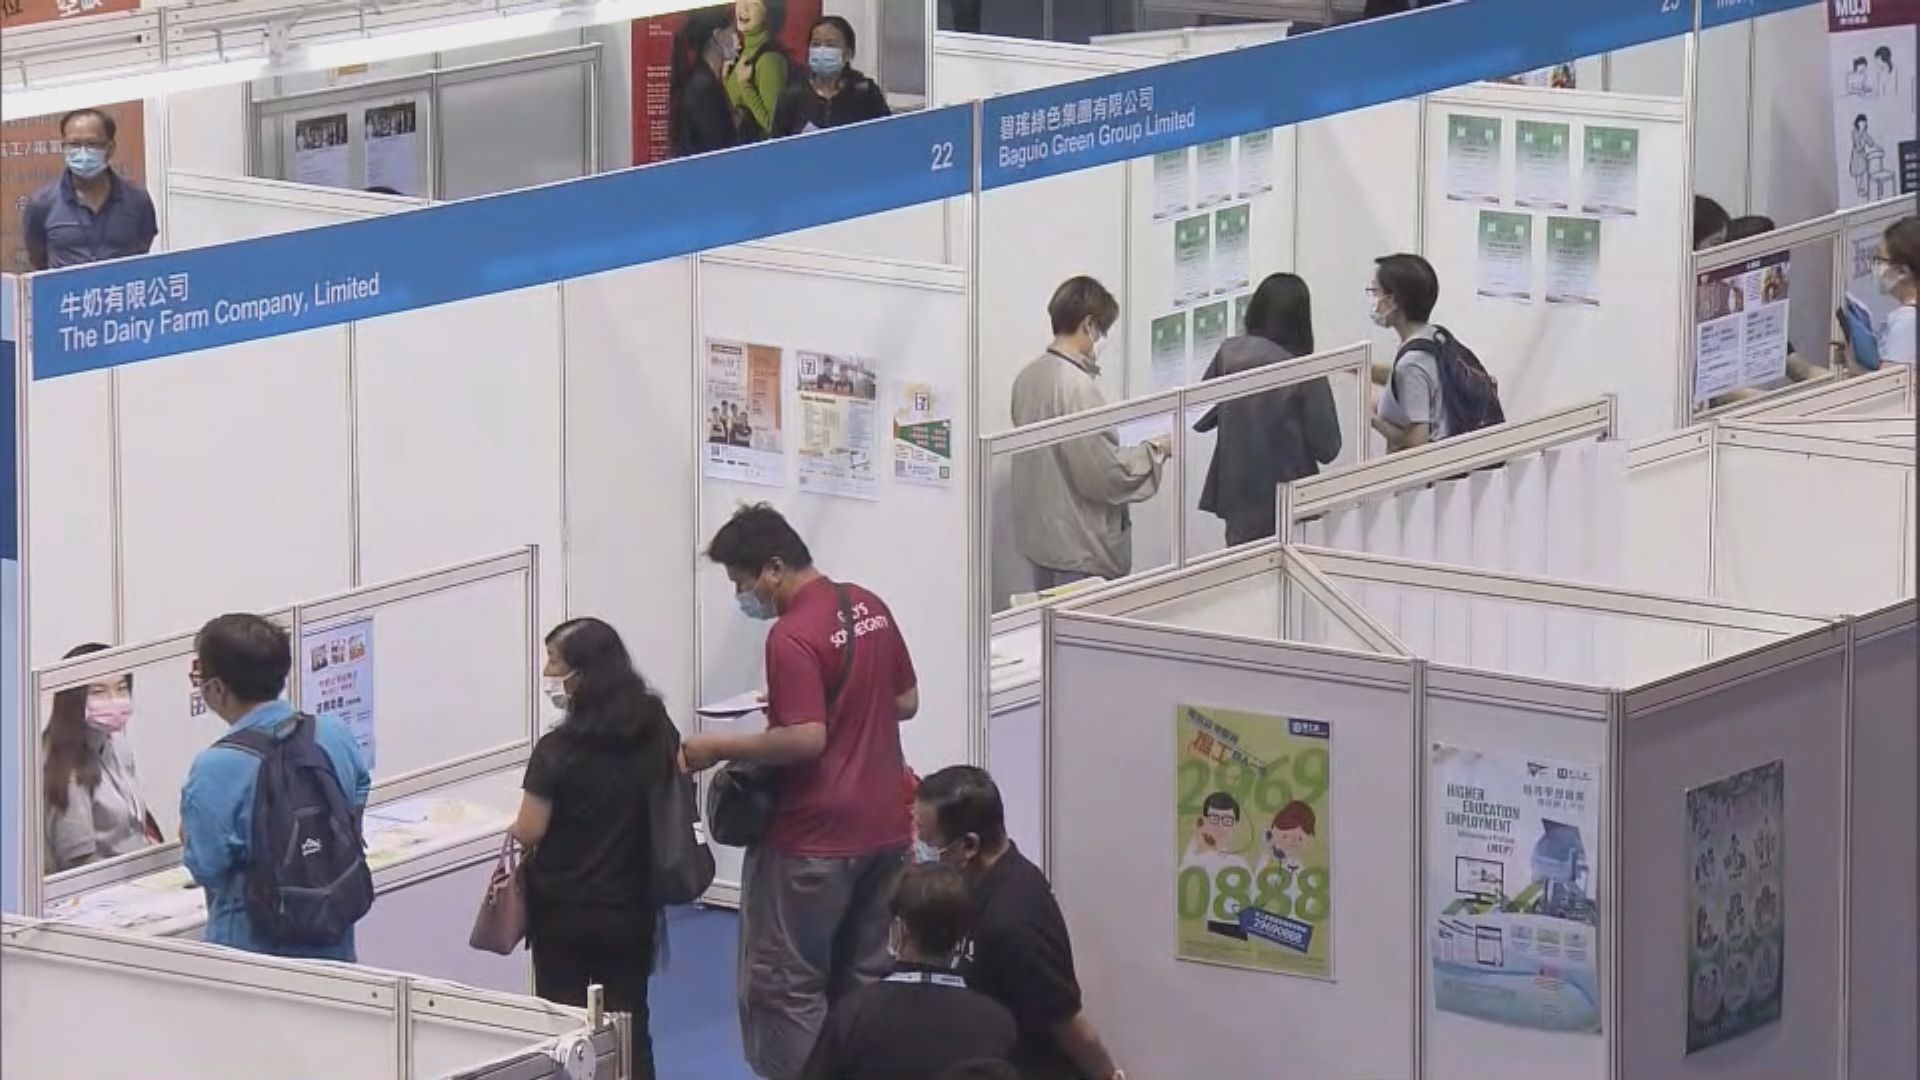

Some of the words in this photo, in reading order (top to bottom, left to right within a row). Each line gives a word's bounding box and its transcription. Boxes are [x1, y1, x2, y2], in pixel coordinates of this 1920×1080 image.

[999, 141, 1049, 169] Baguio
[1052, 131, 1094, 156] Green
[1100, 119, 1142, 146] Group
[1146, 105, 1197, 136] Limited
[930, 142, 953, 171] 22
[60, 272, 188, 320] 牛奶有限公司
[60, 325, 97, 352] The
[104, 317, 154, 345] Dairy
[161, 309, 209, 335] Farm
[215, 289, 308, 323] Company,
[315, 271, 380, 306] Limited
[1447, 783, 1485, 801] HIGHER
[1463, 800, 1520, 819] EDUCATION
[1446, 811, 1512, 834] EMPLOYMENT
[1178, 865, 1329, 922] 0888
